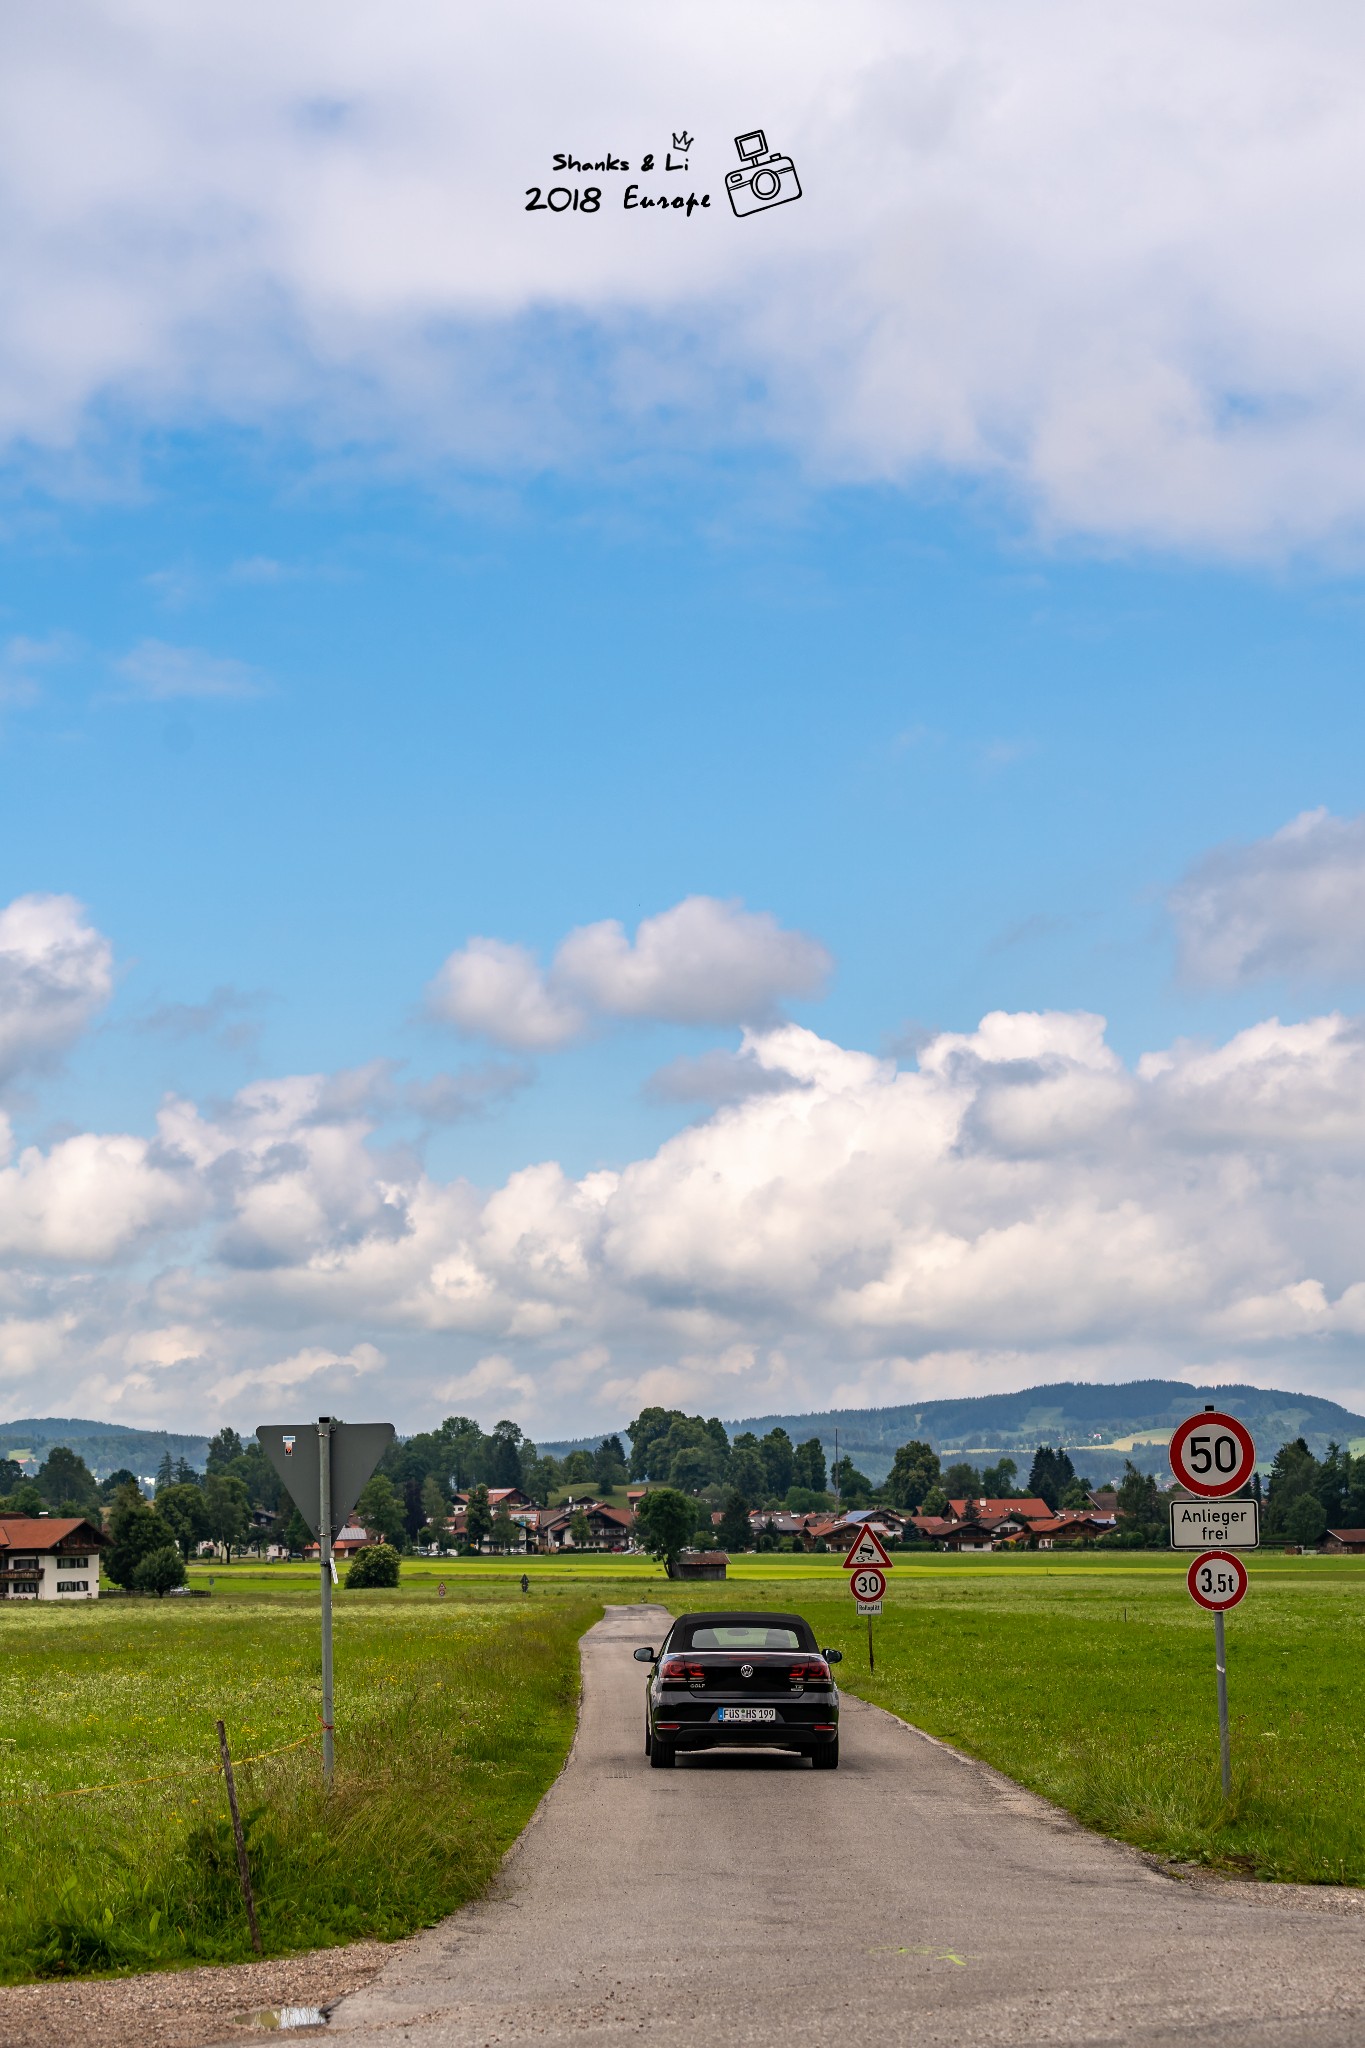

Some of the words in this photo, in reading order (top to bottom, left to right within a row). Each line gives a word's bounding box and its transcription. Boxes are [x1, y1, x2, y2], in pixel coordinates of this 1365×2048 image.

[1190, 1435, 1237, 1474] 50
[1181, 1509, 1247, 1526] Anlieger
[1202, 1527, 1228, 1541] frei
[857, 1576, 879, 1593] 30
[1200, 1568, 1235, 1594] 3,5t
[759, 1709, 774, 1719] 199
